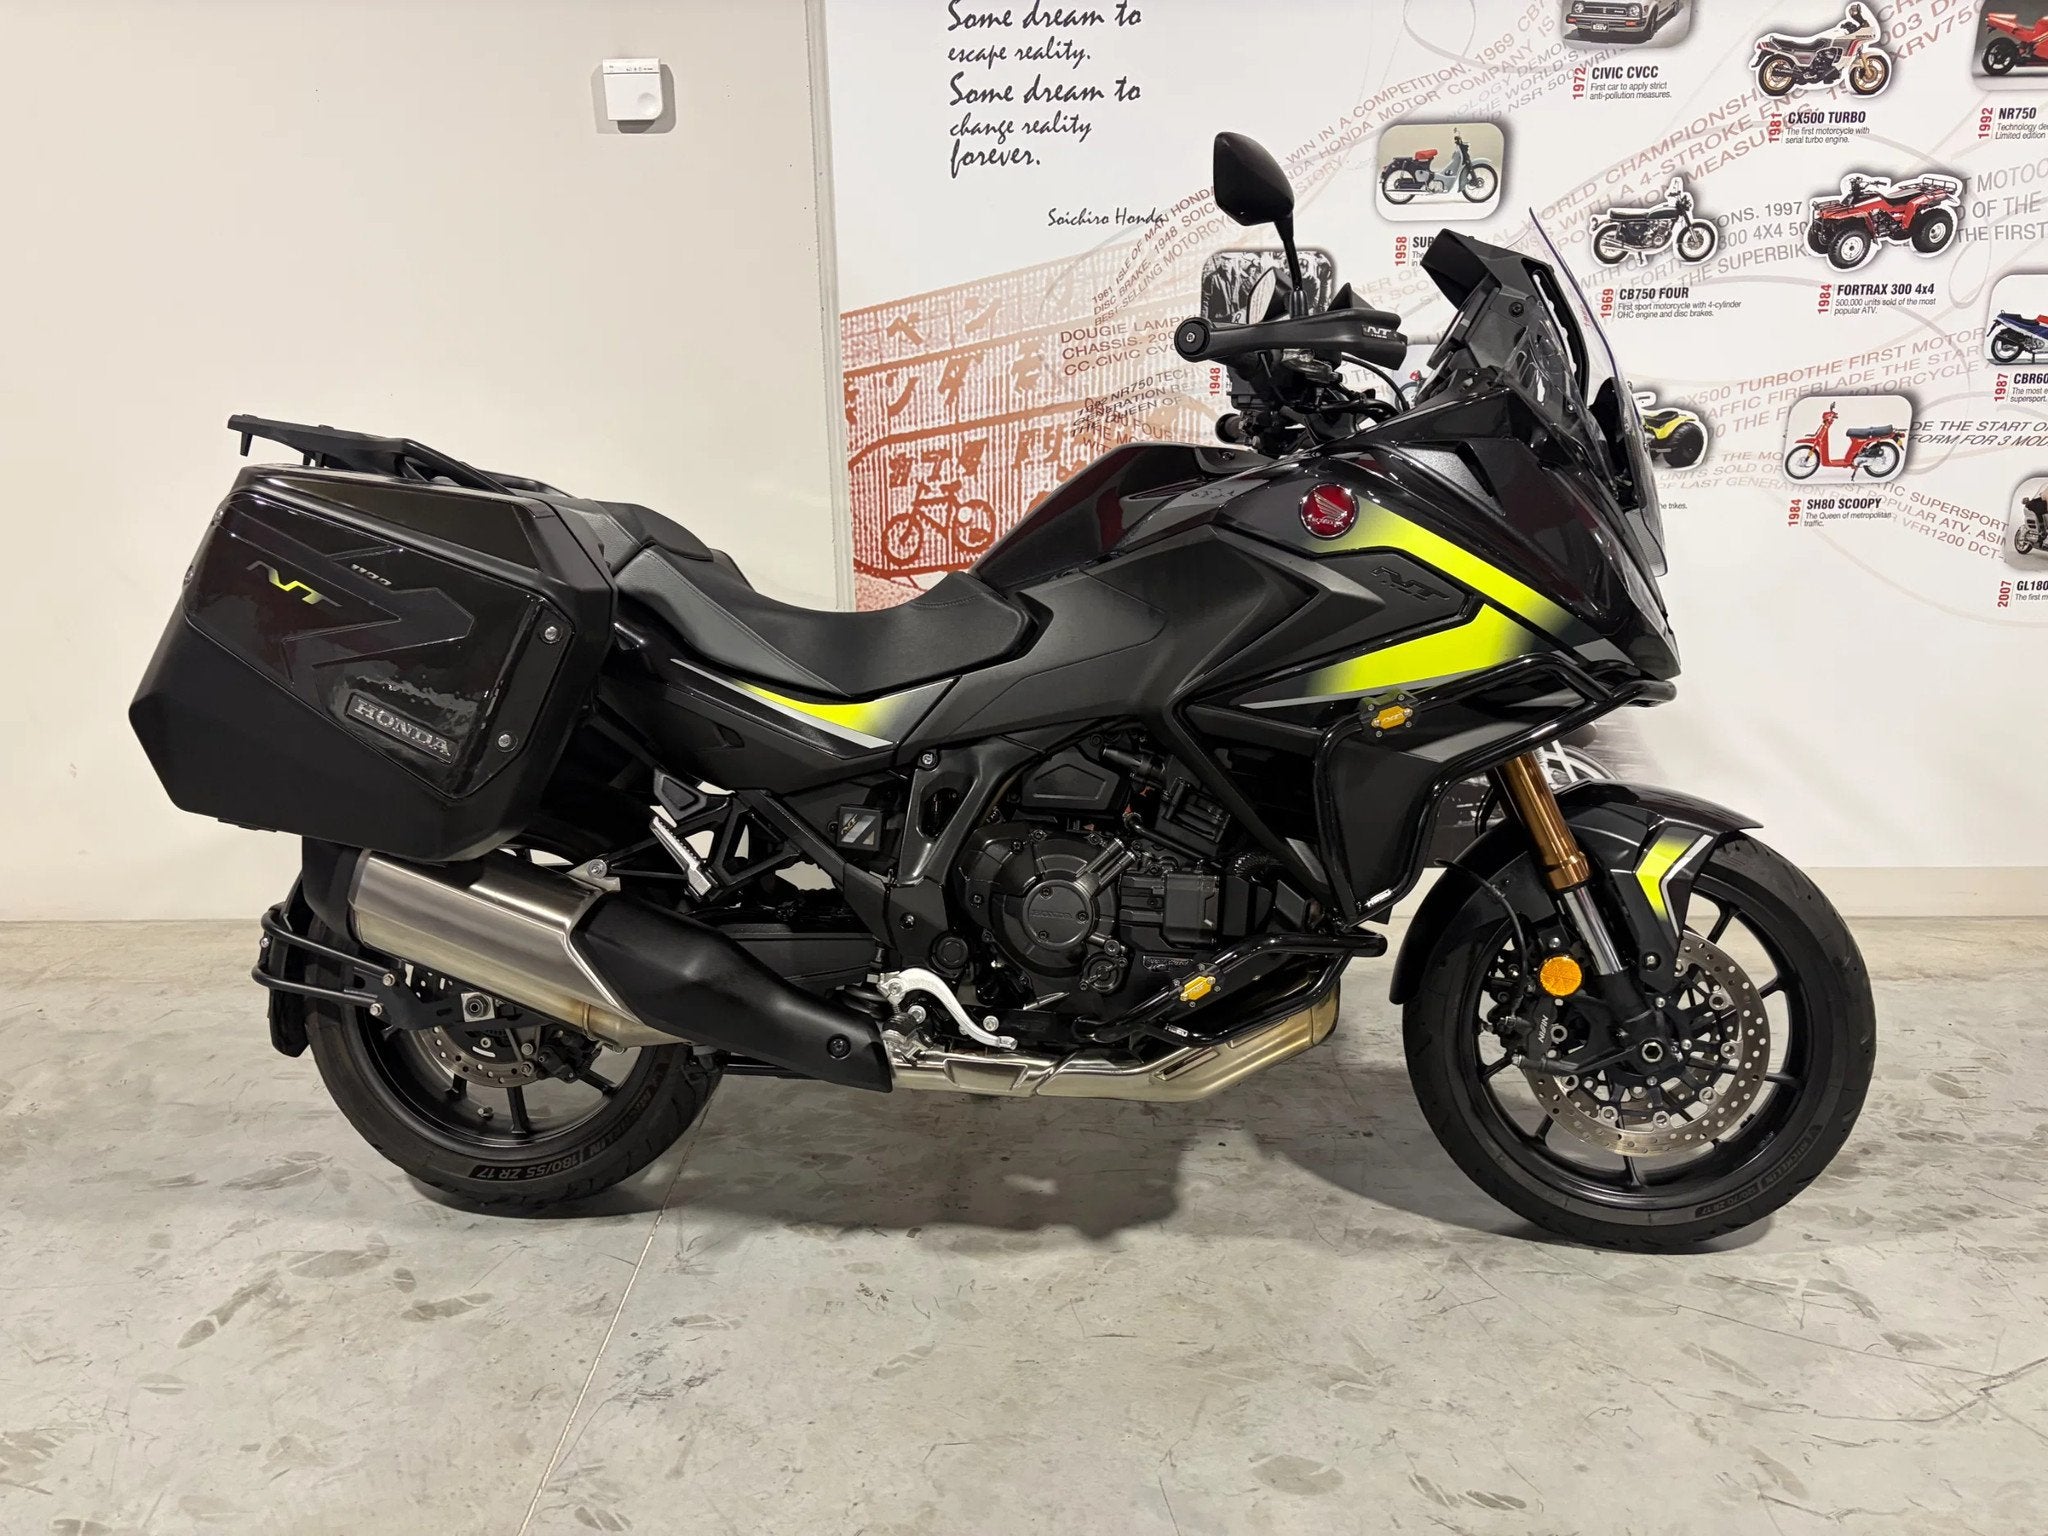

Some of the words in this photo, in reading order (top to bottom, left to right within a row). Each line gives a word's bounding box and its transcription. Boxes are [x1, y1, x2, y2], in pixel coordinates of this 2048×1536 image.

[948, 0, 1013, 31] Some
[1022, 0, 1105, 29] dream
[1114, 1, 1142, 26] to
[948, 44, 1007, 70] escape
[1014, 36, 1091, 69] reality.
[1505, 51, 1579, 99] WORLD'S
[1573, 67, 1586, 99] 1972
[1592, 66, 1623, 79] CIVIC
[1627, 65, 1659, 78] CVCC
[949, 71, 1014, 106] Some
[1023, 73, 1105, 104] dream
[1114, 75, 1141, 102] to
[1319, 120, 1374, 159] HONDA
[1377, 89, 1442, 122] MOTOR
[1447, 39, 1532, 95] COMPANY
[1538, 15, 1556, 38] IS
[1589, 91, 1636, 101] anti-pollution
[1636, 91, 1672, 99] measures.
[1590, 82, 1606, 91] First
[1607, 83, 1619, 91] car
[1620, 82, 1627, 90] to
[1629, 82, 1648, 92] apply
[1650, 81, 1667, 90] strict
[1286, 140, 1316, 164] WIN
[1319, 126, 1335, 142] IN
[1340, 117, 1352, 129] A
[1353, 63, 1472, 118] COMPETITION.
[1475, 33, 1515, 64] 1969
[1508, 88, 1543, 113] NSR
[1788, 111, 1825, 124] CX500
[1828, 111, 1866, 123] TURBO
[1978, 107, 1993, 139] 1992
[1998, 107, 2037, 119] NR750
[949, 112, 1015, 144] change
[1021, 110, 1092, 143] reality
[1768, 113, 1782, 144] 1981
[1787, 127, 1800, 136] The
[1801, 127, 1814, 135] first
[1816, 127, 1854, 136] motorcycle
[1855, 127, 1870, 135] with
[1995, 132, 2021, 140] Limited
[2022, 132, 2046, 140] edition
[1997, 122, 2037, 132] Technology
[1640, 113, 1754, 185] 4-STROKE
[1785, 136, 1804, 144] serial
[1805, 136, 1822, 144] turbo
[1825, 136, 1850, 145] engine.
[950, 138, 1041, 179] forever.
[1764, 201, 1803, 217] 1997
[1973, 199, 1998, 219] OF
[2003, 190, 2042, 216] THE
[1048, 207, 1109, 227] Soichiro
[1115, 207, 1165, 227] Honda
[1753, 222, 1784, 240] 4X4
[1956, 226, 1989, 243] THE
[1994, 221, 2048, 240] FIRST
[1092, 286, 1114, 304] 1961
[1115, 260, 1132, 284] ISLE
[1131, 240, 1144, 261] OF
[1144, 213, 1171, 243] MAN
[1395, 236, 1407, 266] 1958
[1093, 296, 1117, 315] DISC
[1154, 226, 1179, 255] 1948
[1094, 263, 1164, 327] BEST-SELLING
[1619, 288, 1656, 300] CB750
[1659, 287, 1689, 299] FOUR
[1818, 284, 1832, 314] 1984
[1837, 283, 1888, 296] FORTRAX
[1890, 283, 1912, 295] 300
[1914, 283, 1935, 294] 4x4
[1600, 289, 1614, 318] 1969
[1618, 303, 1633, 311] First
[1634, 303, 1651, 312] sport
[1653, 302, 1691, 312] motorcycle
[1692, 301, 1706, 309] with
[1707, 300, 1741, 310] 4-cylinder
[1834, 307, 1860, 316] popular
[1882, 298, 1896, 306] sold
[1899, 298, 1906, 306] of
[1906, 298, 1918, 306] the
[1617, 310, 1634, 319] OHC
[1635, 311, 1658, 320] engine
[1659, 310, 1672, 318] and
[1673, 309, 1688, 318] disc
[1689, 309, 1714, 318] brakes.
[1060, 322, 1128, 344] DOUGIE
[1062, 336, 1144, 361] CHASSIS.
[1064, 347, 1141, 377] CC.CIVIC
[1736, 359, 1843, 395] TURBOTHE
[1849, 345, 1906, 369] FIRST
[1111, 376, 1154, 402] NR750
[1209, 367, 1221, 396] 1948
[1767, 370, 1875, 405] FIREBLADE
[1881, 358, 1921, 376] THE
[1994, 373, 2008, 402] 1987
[2012, 387, 2026, 395] The
[2025, 387, 2043, 395] most
[1734, 411, 1769, 432] THE
[1939, 421, 1973, 432] THE
[1976, 421, 2031, 432] START
[1960, 434, 1997, 446] FOR
[1997, 435, 2012, 446] 3
[1668, 502, 1687, 510] trikes.
[1788, 499, 1802, 527] 1984
[1806, 498, 1835, 510] SH80
[1837, 497, 1882, 509] SCOOPY
[1909, 491, 2010, 533] SUPERSPORT
[1803, 520, 1825, 528] traffic.
[1805, 512, 1818, 520] The
[1819, 512, 1840, 520] Queen
[1850, 512, 1892, 521] metropolitan
[1940, 516, 1971, 536] ATV.
[1997, 580, 2012, 607] 2007
[2015, 593, 2027, 601] The
[2028, 593, 2041, 601] first
[355, 699, 452, 757] HONDA
[476, 1168, 495, 1179] 17
[499, 1168, 519, 1180] ZR
[525, 1153, 579, 1179] 180/55
